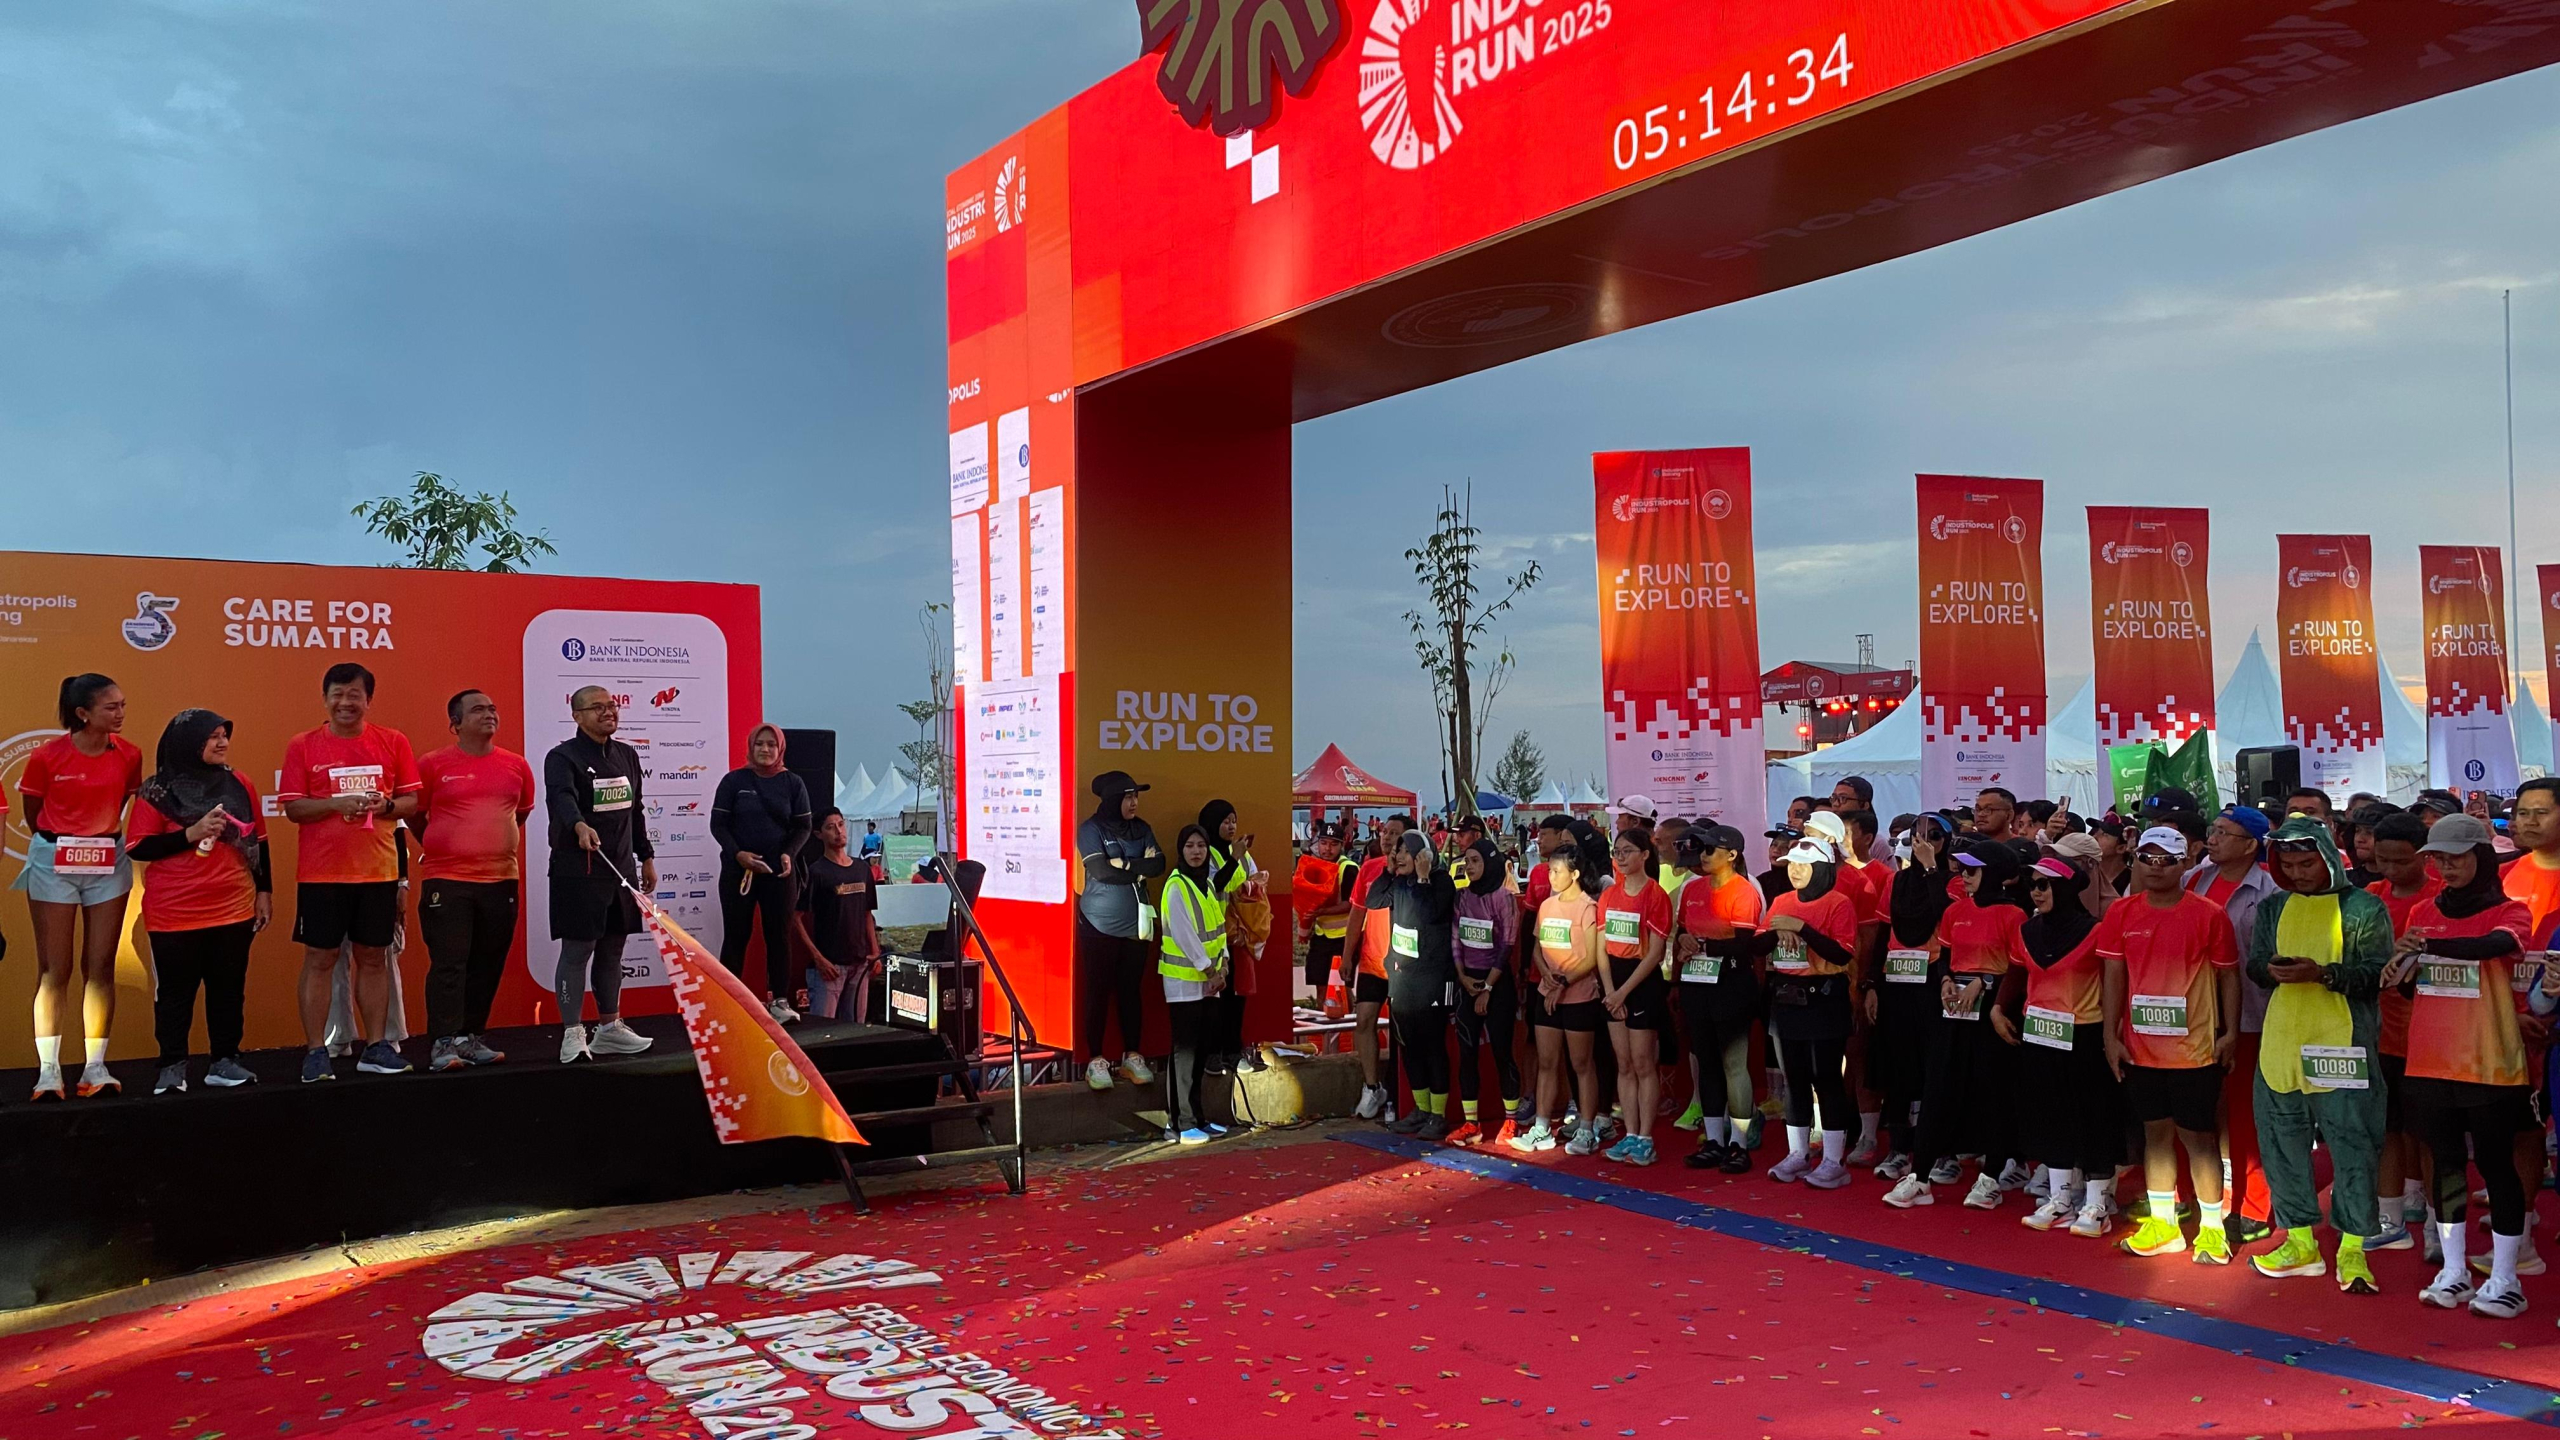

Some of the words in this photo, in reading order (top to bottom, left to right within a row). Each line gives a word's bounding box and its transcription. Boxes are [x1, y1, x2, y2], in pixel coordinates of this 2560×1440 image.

[1452, 0, 1545, 46] IND
[1452, 15, 1536, 97] RUN
[1542, 0, 1612, 56] 2025
[1612, 32, 1854, 171] 05:14:34
[1631, 499, 1690, 508] INDUSTROPOLIS
[1638, 563, 1691, 586] RUN
[1700, 561, 1731, 583] TO
[1615, 586, 1731, 612] EXPLORE
[1949, 581, 1993, 601] RUN
[2000, 582, 2026, 602] TO
[223, 597, 314, 623] CARE
[328, 601, 392, 625] FOR
[1929, 603, 2024, 625] EXPLORE
[2121, 600, 2163, 618] RUN
[2170, 601, 2193, 619] TO
[224, 624, 395, 650] SUMATRA
[2103, 620, 2194, 640] EXPLORE
[2304, 620, 2337, 637] RUN
[2343, 620, 2362, 636] TO
[2442, 624, 2474, 640] RUN
[590, 645, 622, 656] BANK
[625, 646, 690, 658] INDONESIA
[2289, 638, 2363, 657] EXPLORE
[2432, 641, 2498, 657] EXPLORE
[1116, 690, 1197, 721] RUN
[1208, 694, 1258, 723] TO
[1099, 720, 1274, 753] EXPLORE
[339, 776, 377, 790] 60204
[660, 770, 698, 780] mandiri
[601, 787, 628, 801] 70025
[670, 833, 684, 841] BSI
[65, 848, 107, 862] 60561
[662, 873, 679, 881] PPA
[1464, 926, 1486, 940] 10538
[1611, 920, 1633, 934] 70011
[1689, 960, 1714, 973] 10542
[1892, 959, 1921, 972] 10408
[2428, 965, 2467, 983] 10031
[2513, 962, 2540, 979] 100
[2140, 1007, 2176, 1023] 10081
[2032, 1018, 2063, 1037] 10133
[2311, 1058, 2357, 1075] 10080
[839, 1301, 950, 1358] SPECIAL
[616, 1325, 811, 1418] RUN
[928, 1351, 1094, 1434] ECONOMIC
